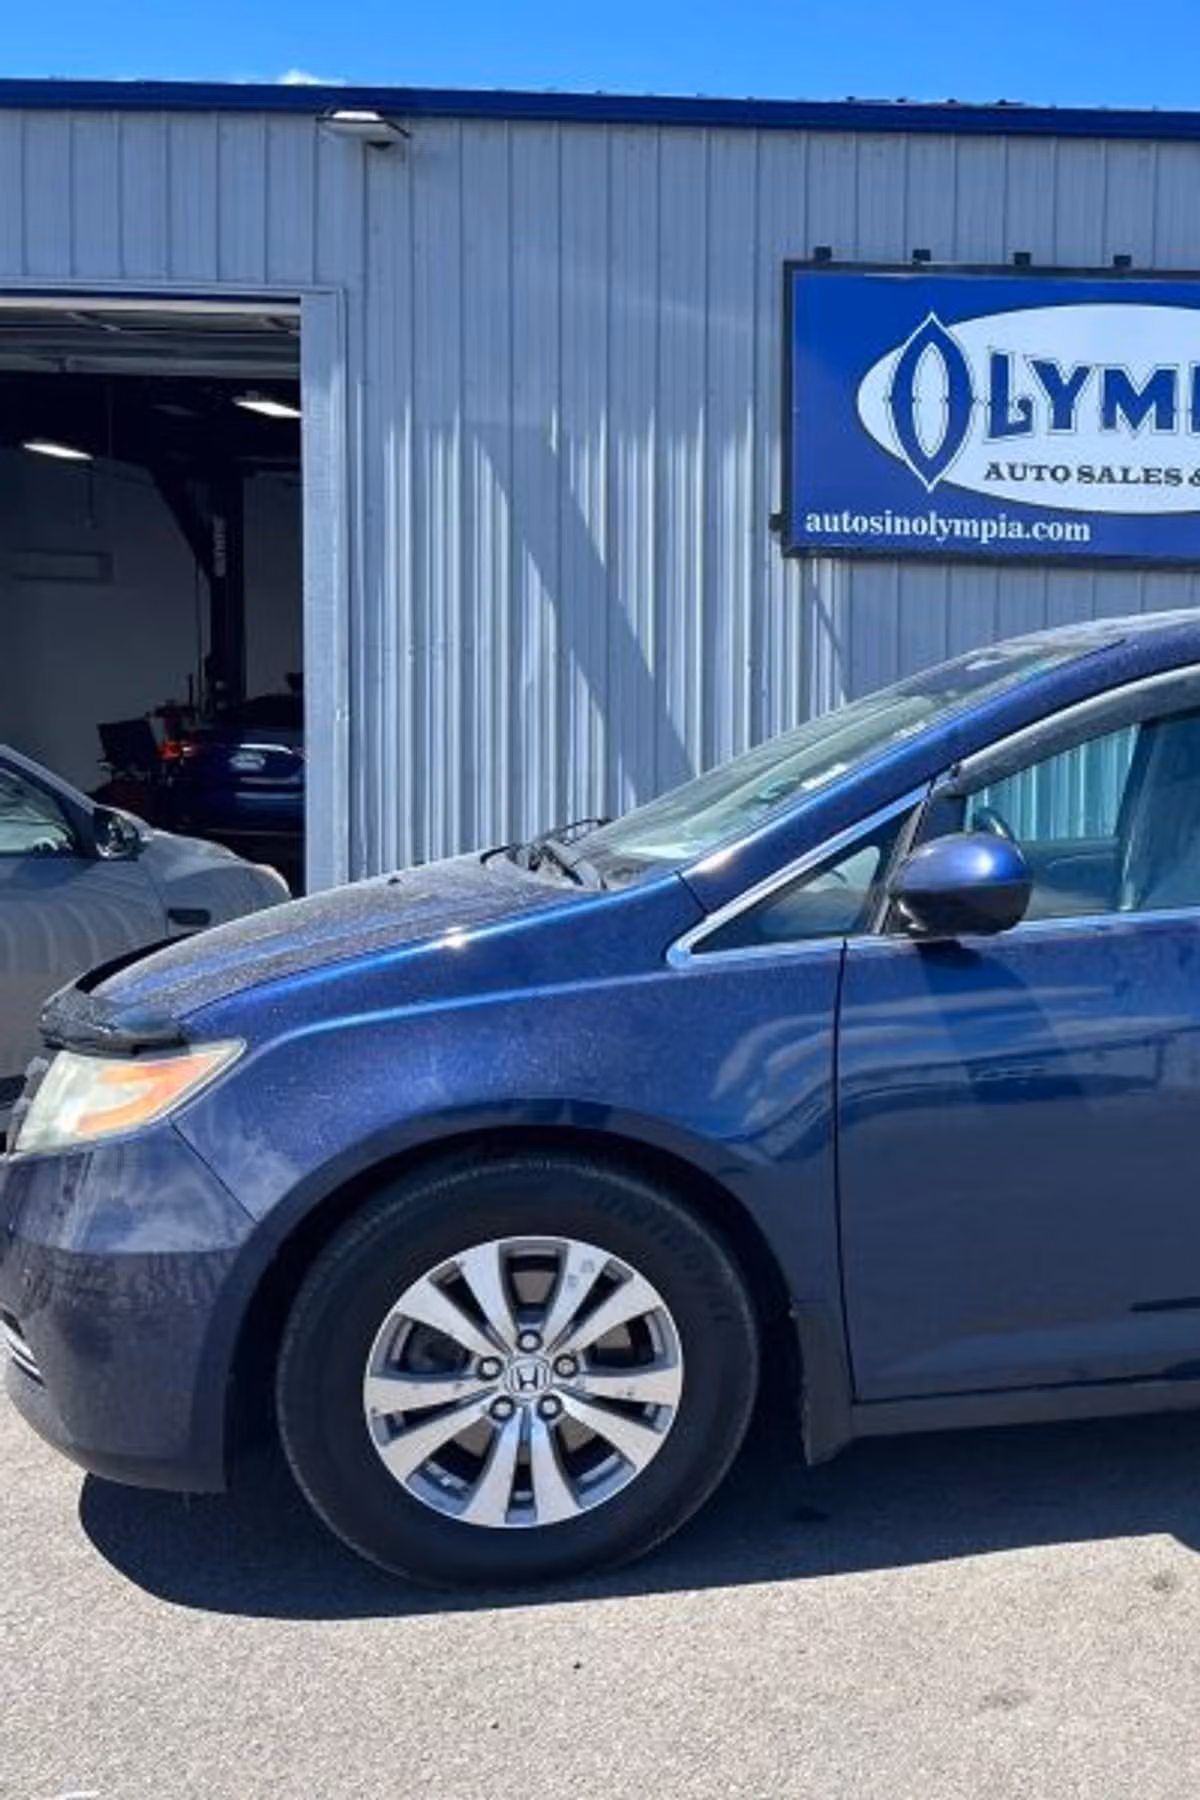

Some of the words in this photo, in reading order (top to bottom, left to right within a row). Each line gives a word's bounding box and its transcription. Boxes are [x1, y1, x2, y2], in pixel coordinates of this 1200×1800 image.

[984, 461, 1072, 482] AUTO
[1076, 464, 1184, 486] SALES
[805, 509, 1092, 544] autosinolympia.com
